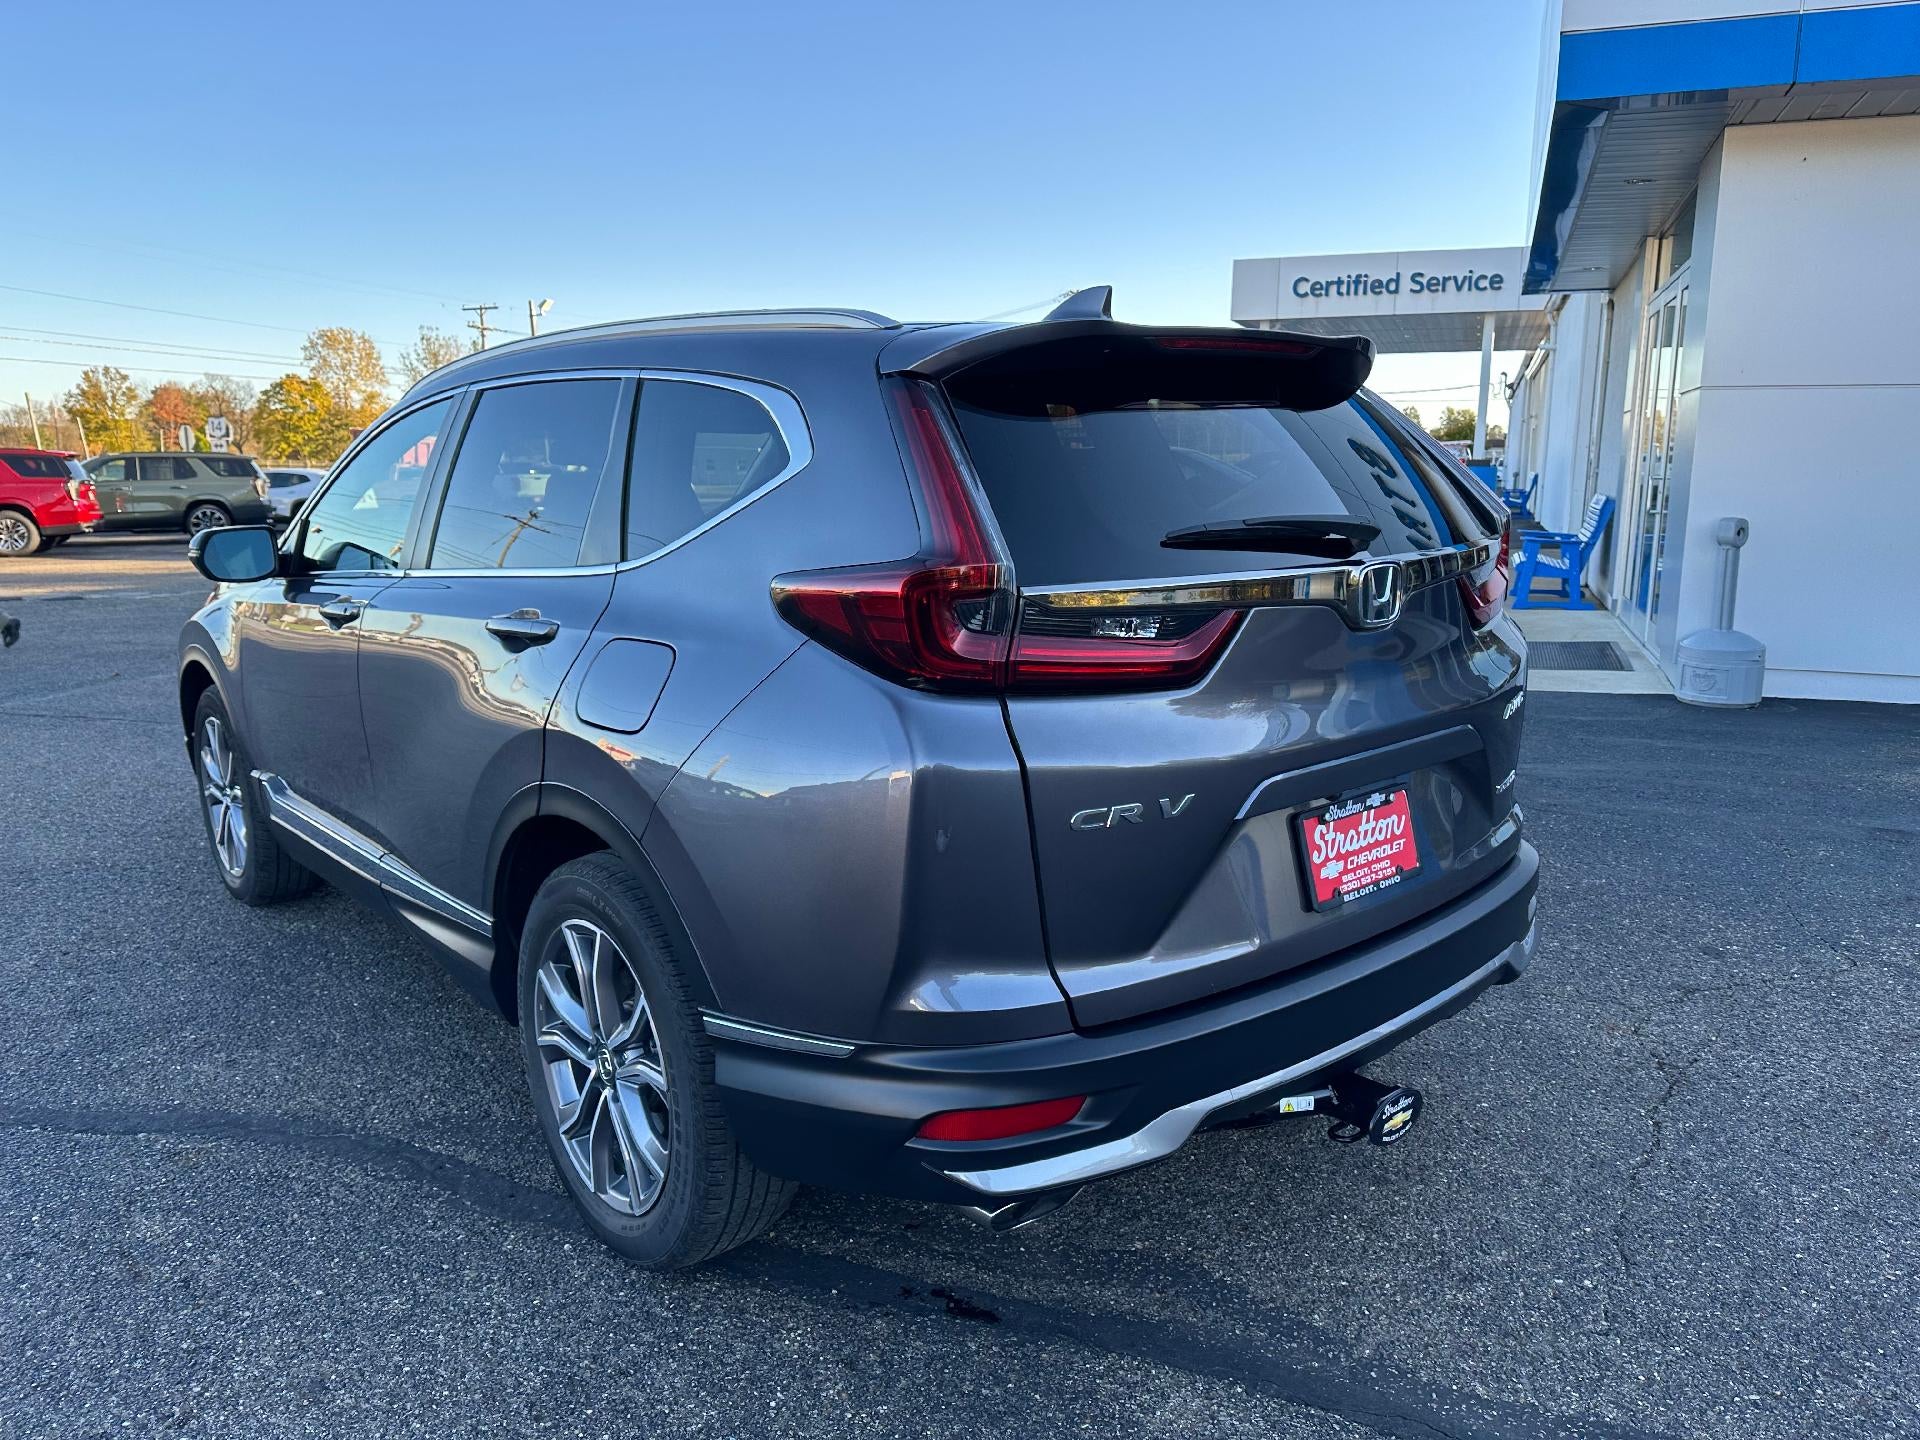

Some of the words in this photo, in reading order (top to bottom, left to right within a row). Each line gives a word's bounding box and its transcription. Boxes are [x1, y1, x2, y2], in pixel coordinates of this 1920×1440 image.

[1292, 271, 1401, 298] Certified
[1409, 269, 1504, 293] Service
[210, 420, 223, 433] 14
[1329, 800, 1365, 821] Stratton
[1312, 809, 1406, 864] Stratton
[1347, 838, 1407, 870] CHEVROLET
[1341, 867, 1371, 883] BELOIT,
[1371, 859, 1391, 872] OHIO
[1343, 885, 1378, 902] BELOIT,
[1379, 875, 1401, 889] OHIO
